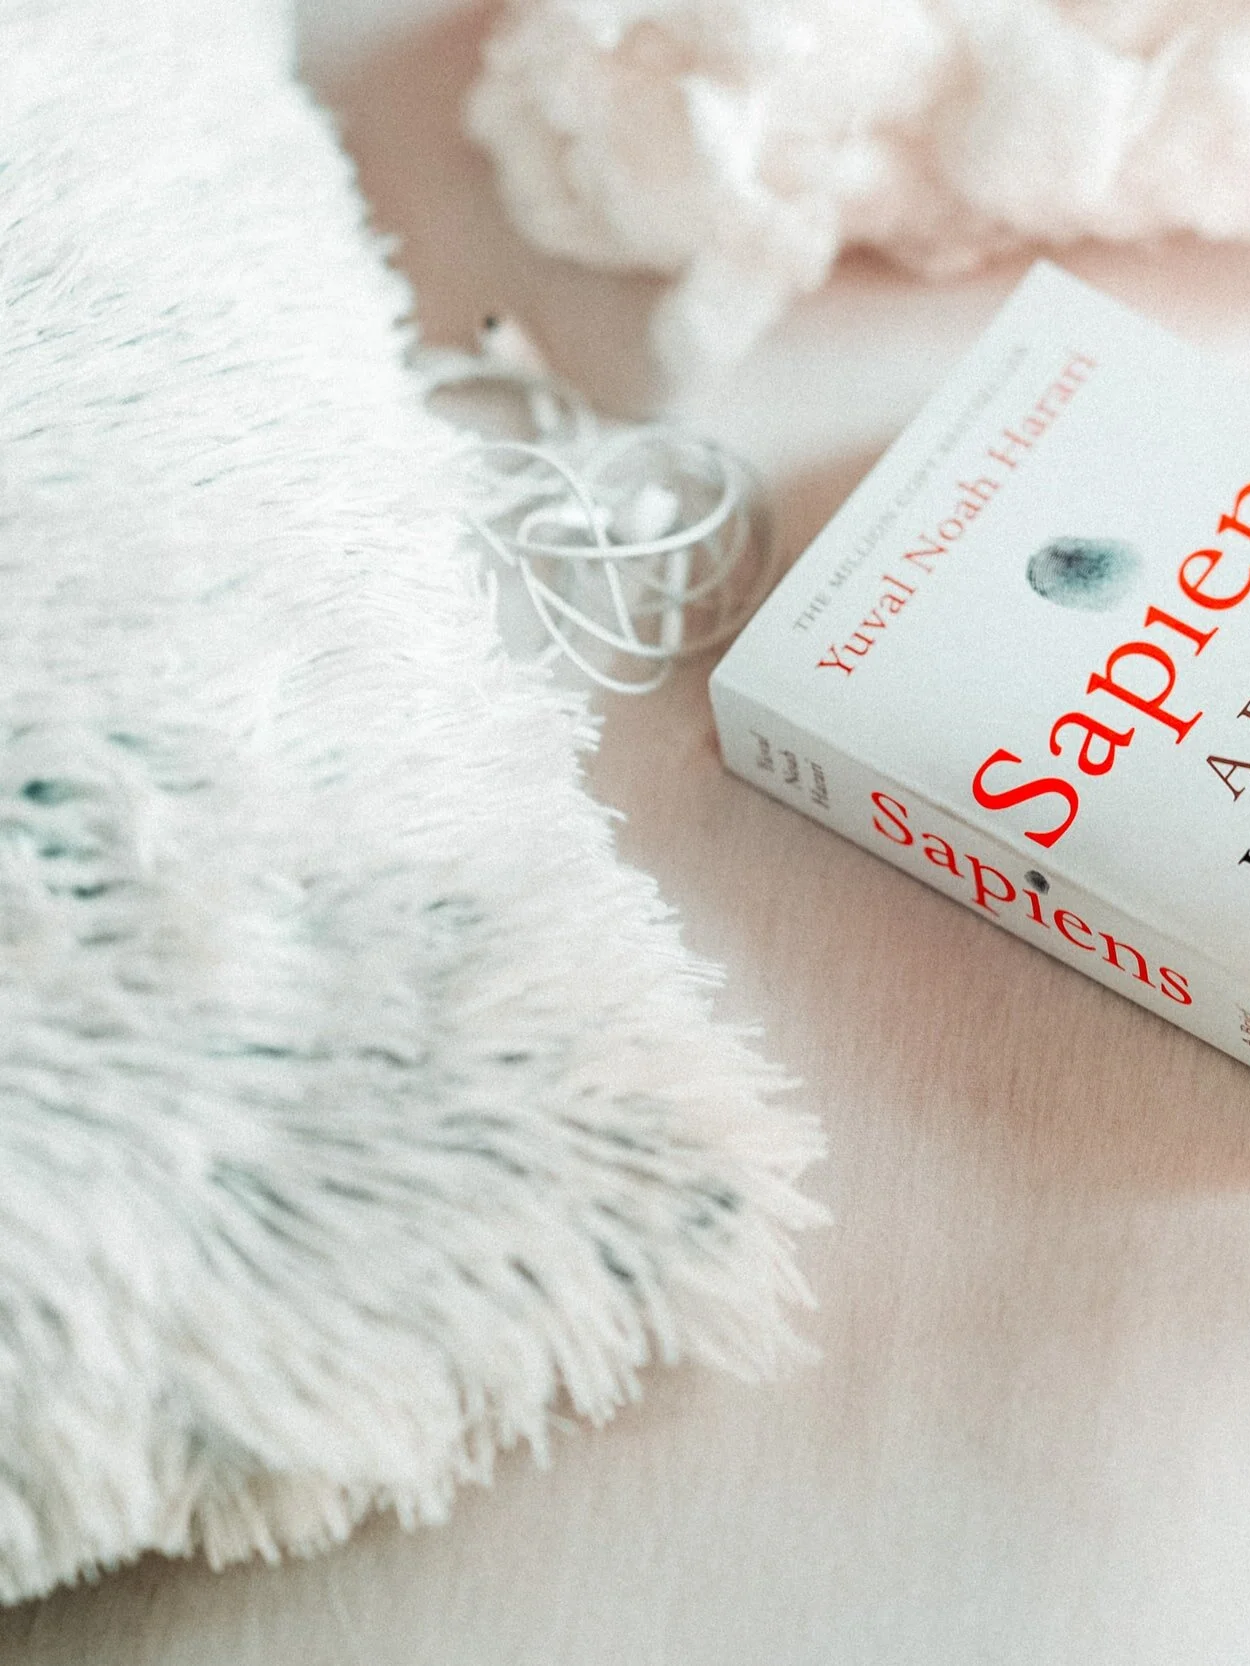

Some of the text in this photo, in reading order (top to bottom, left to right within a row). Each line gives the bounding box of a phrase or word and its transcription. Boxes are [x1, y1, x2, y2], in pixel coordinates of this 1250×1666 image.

[791, 591, 831, 631] THE
[815, 574, 916, 677] Yuval
[901, 477, 1001, 576] Noah
[986, 352, 1097, 471] Harari
[870, 790, 1194, 1006] Sapiens
